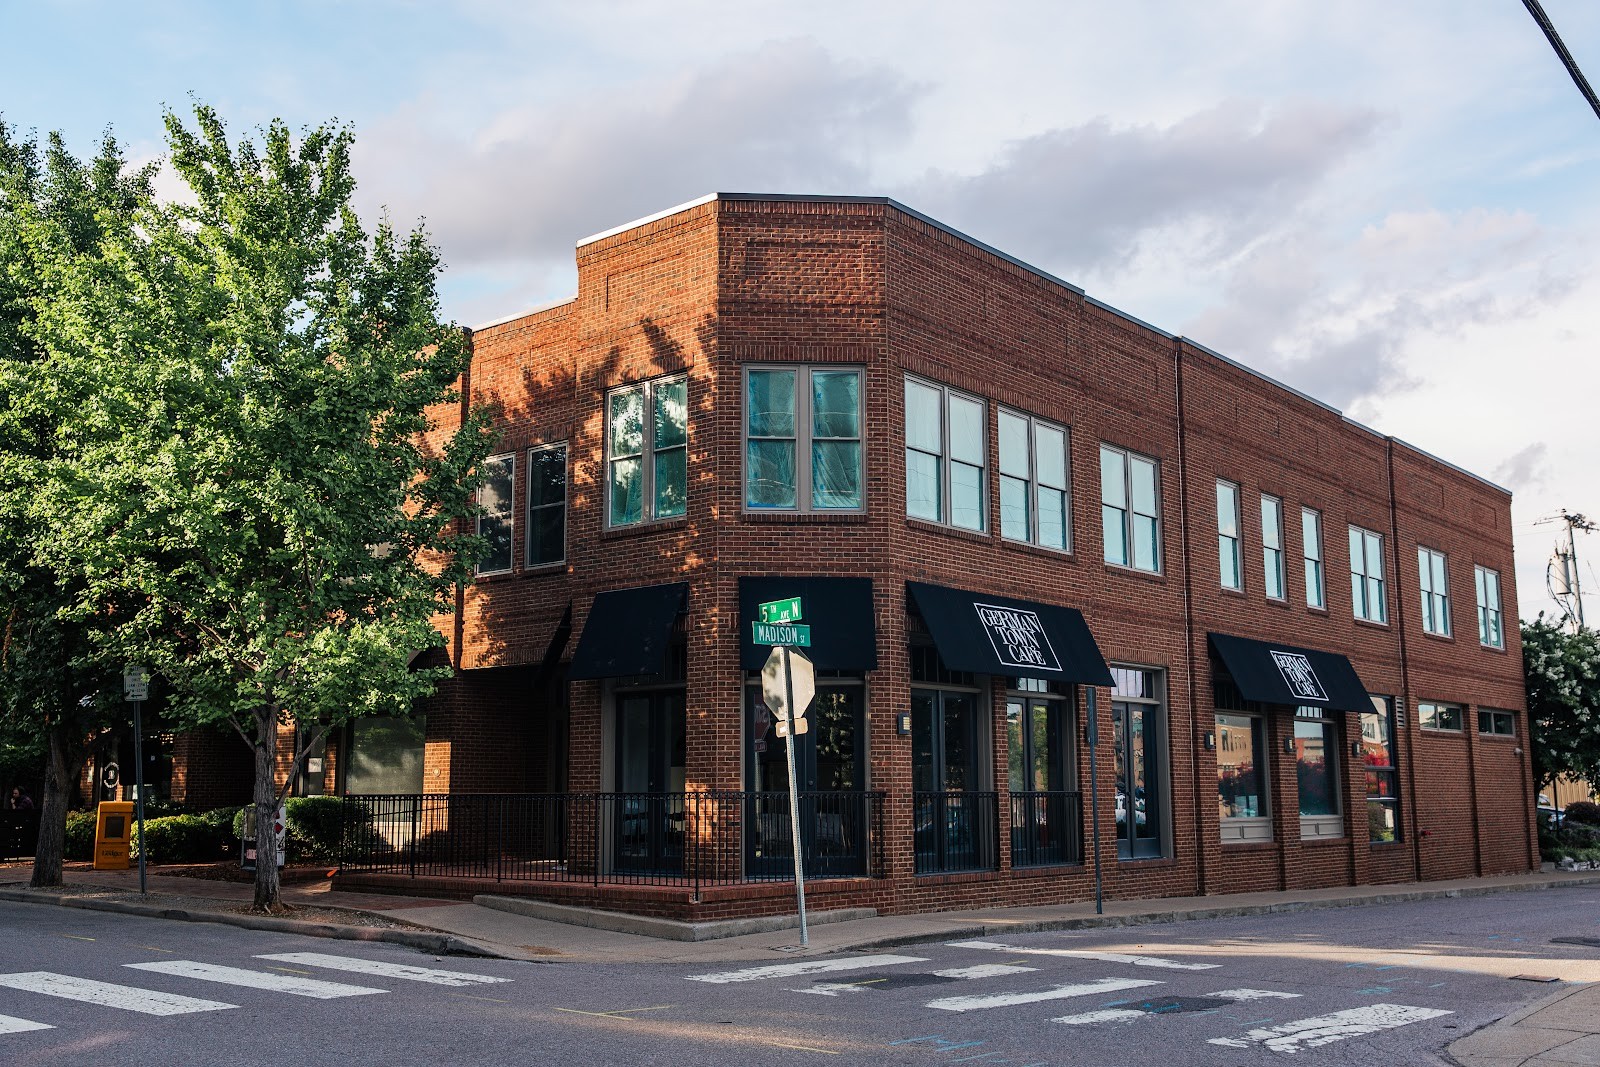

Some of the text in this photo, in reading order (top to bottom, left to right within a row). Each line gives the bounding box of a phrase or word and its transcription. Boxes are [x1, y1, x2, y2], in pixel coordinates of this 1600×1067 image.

[780, 609, 790, 620] AVE
[791, 600, 799, 617] N
[980, 608, 1041, 633] GERMAN
[758, 625, 805, 643] MADISON ST
[994, 626, 1041, 648] TOWN
[1273, 653, 1312, 672] GERMAN
[1284, 667, 1314, 684] TOWN
